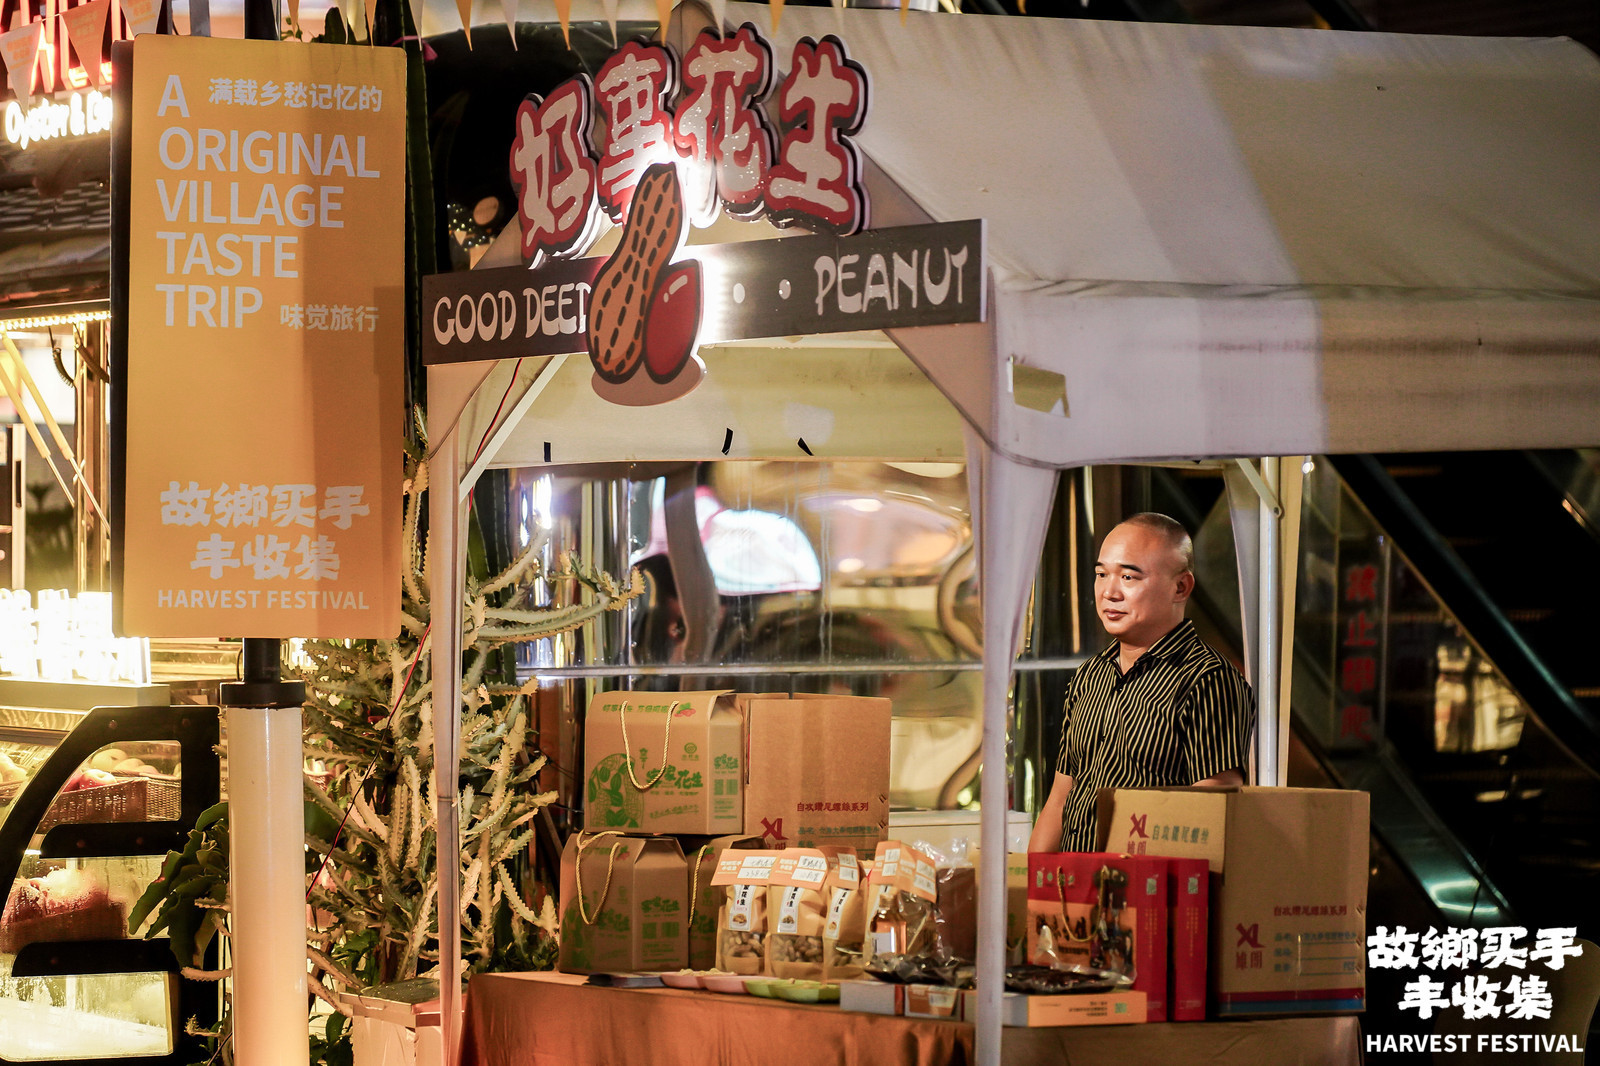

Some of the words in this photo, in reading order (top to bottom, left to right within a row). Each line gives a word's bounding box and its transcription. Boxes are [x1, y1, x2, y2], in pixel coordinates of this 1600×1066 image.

[157, 75, 190, 117] A
[208, 77, 382, 113] 满载乡愁记忆的
[159, 126, 380, 178] ORIGINAL
[512, 30, 862, 253] 好事花生
[156, 179, 344, 229] VILLAGE
[156, 231, 299, 279] TASTE
[155, 283, 263, 329] TRIP
[280, 304, 379, 332] 味觉旅行
[433, 290, 517, 345] GOOD
[813, 244, 968, 317] PEANUT
[160, 480, 370, 530] 故鄉买手
[190, 533, 341, 581] 丰收集
[158, 589, 261, 609] HARVEST
[266, 590, 370, 610] FESTIVAL
